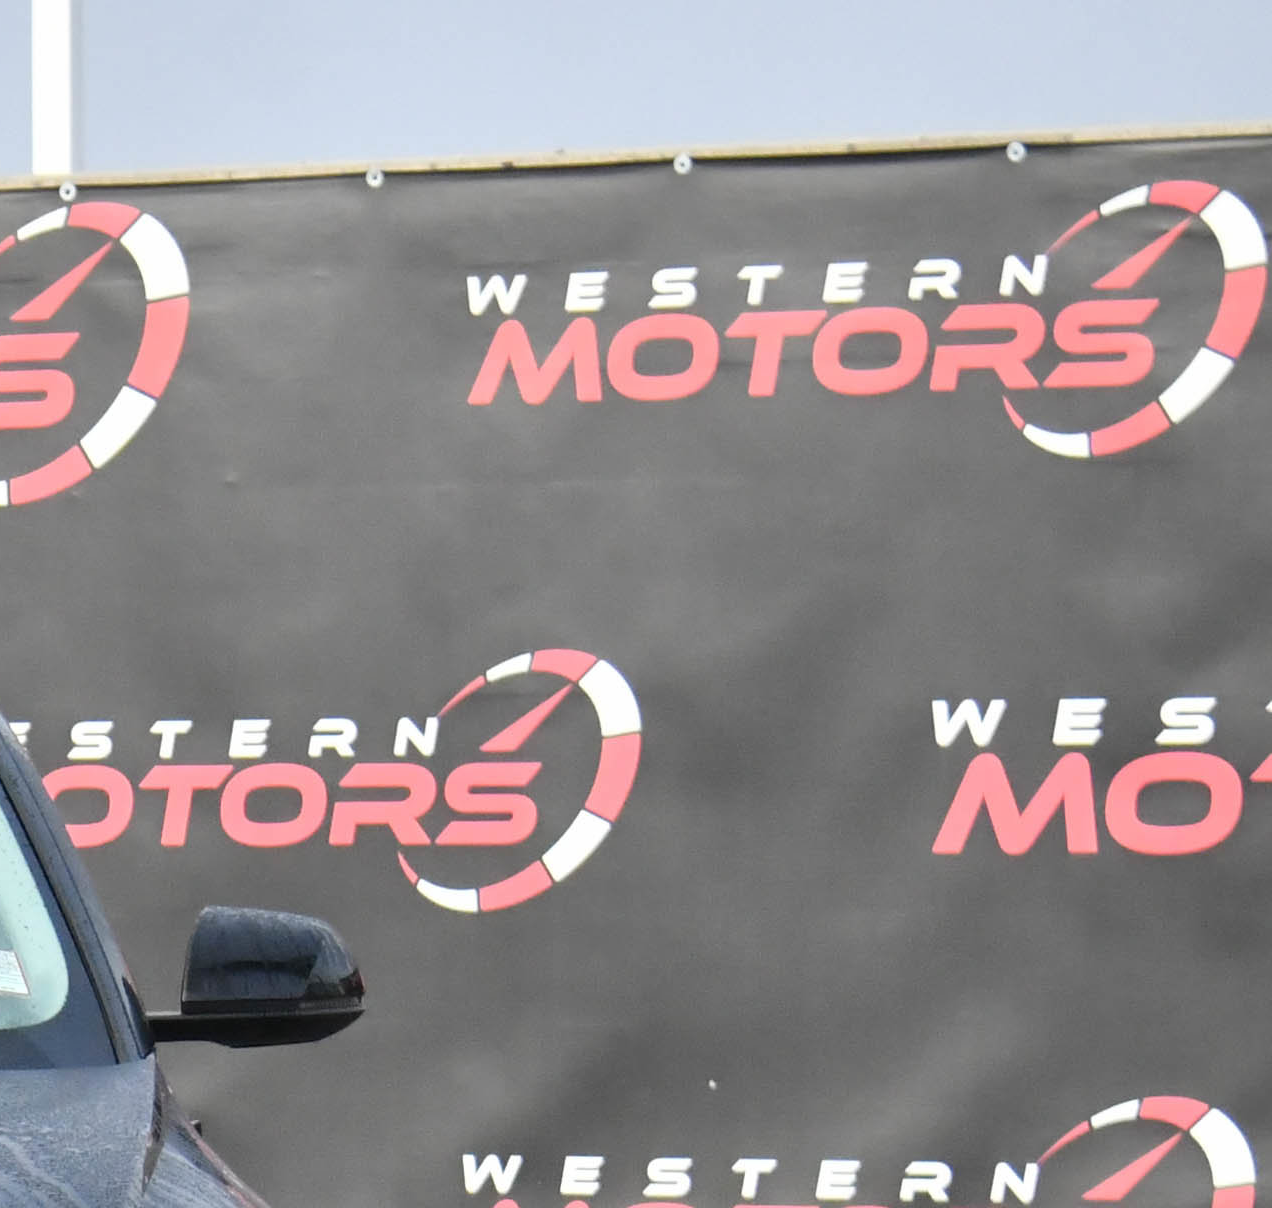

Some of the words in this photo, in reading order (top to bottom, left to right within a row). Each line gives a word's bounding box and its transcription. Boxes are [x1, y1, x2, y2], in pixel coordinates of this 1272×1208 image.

[466, 253, 1048, 316] WESTERN
[467, 298, 1159, 406] MOTORS
[8, 716, 440, 761] STERN
[462, 1153, 1040, 1205] WESTERN
